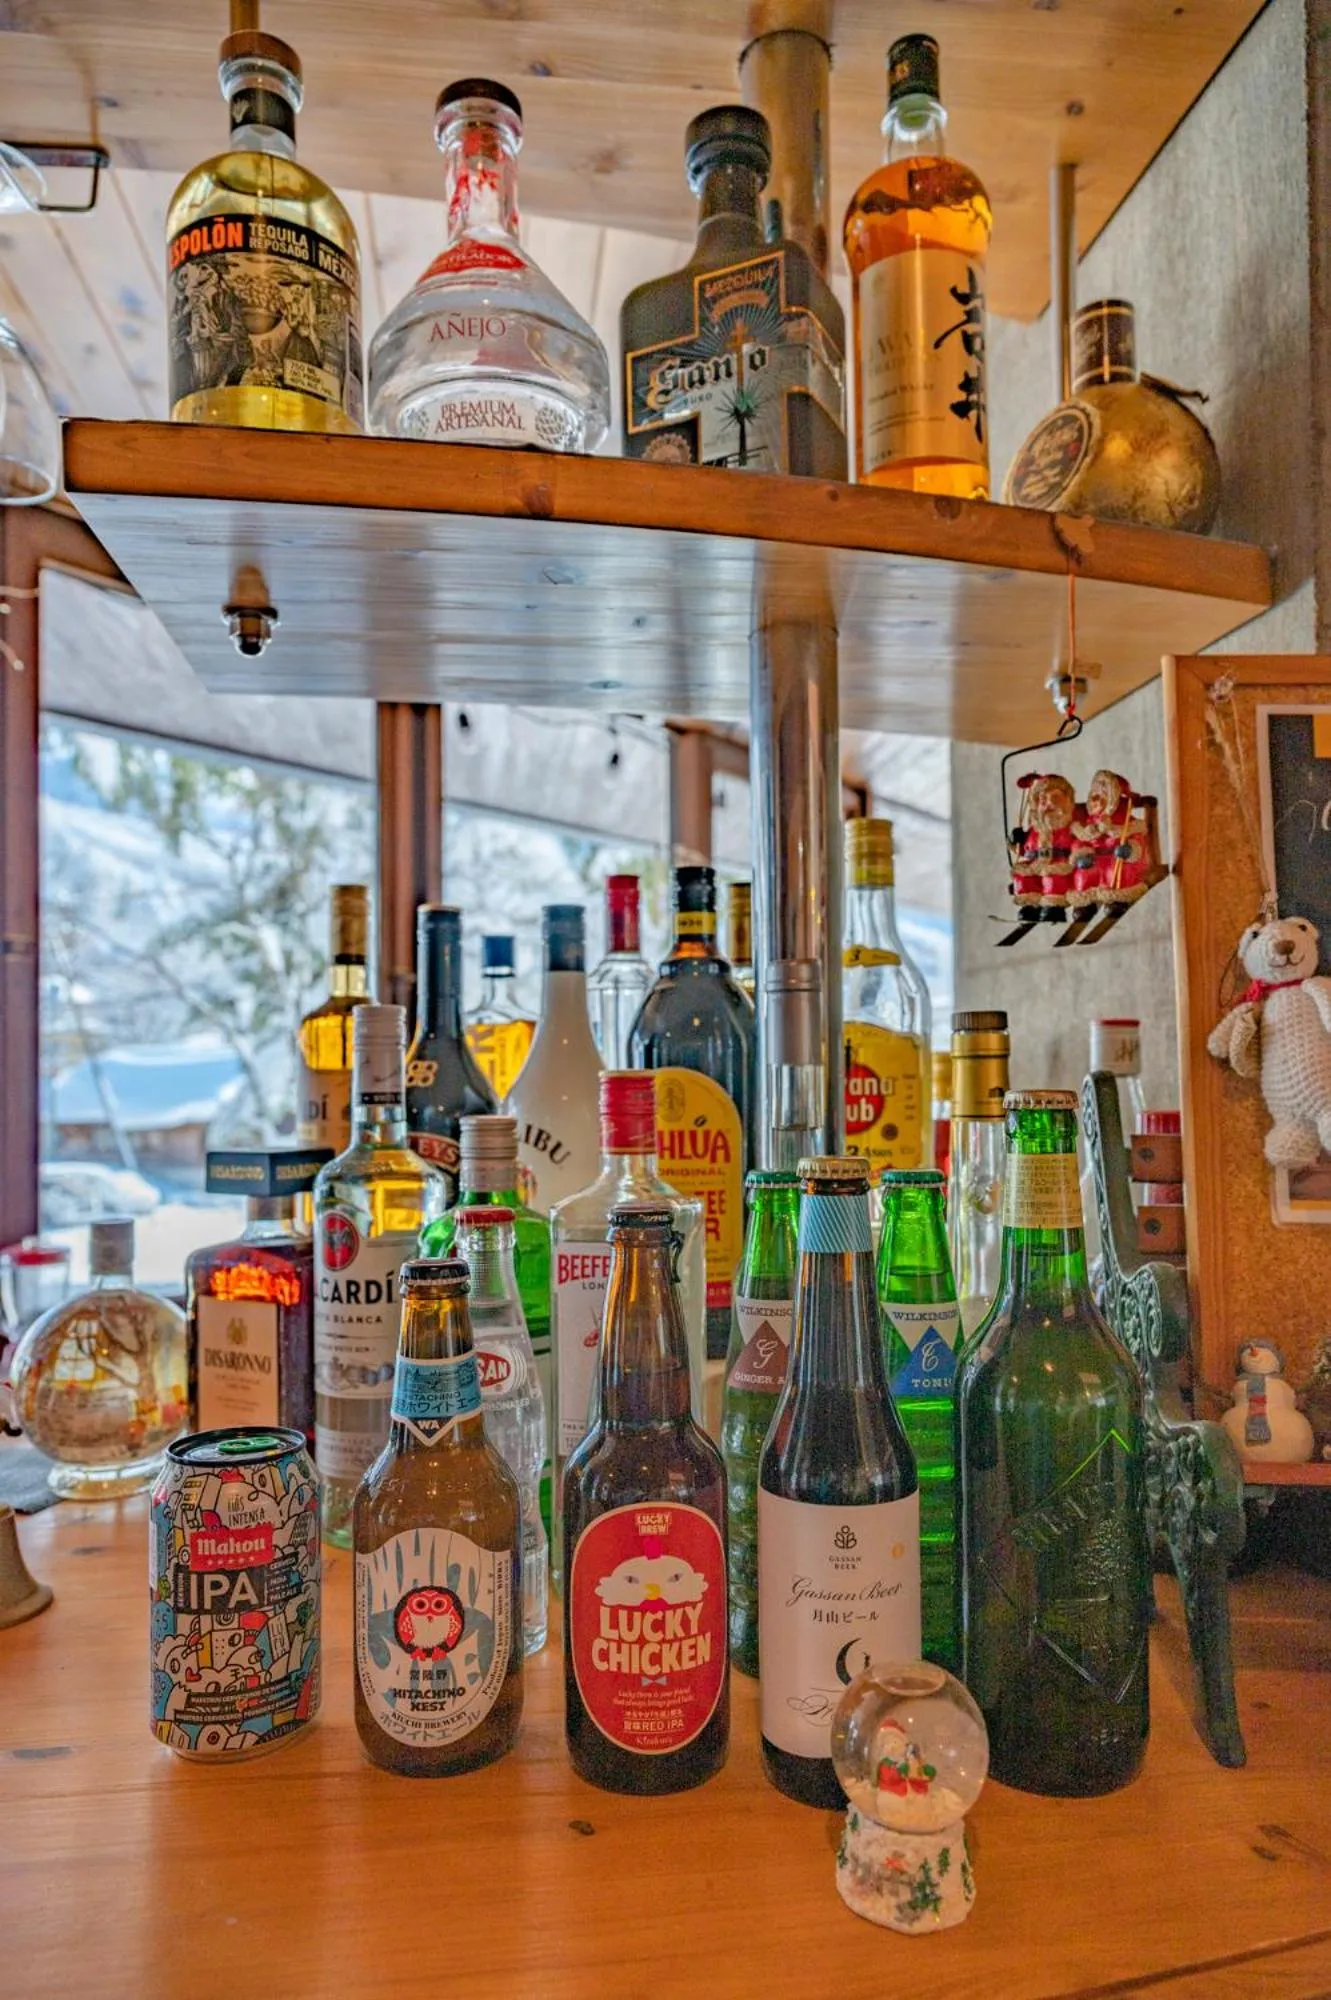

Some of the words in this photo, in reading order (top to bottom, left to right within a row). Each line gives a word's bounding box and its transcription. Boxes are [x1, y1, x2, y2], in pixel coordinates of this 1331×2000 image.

[248, 222, 309, 249] TEQUILA
[249, 236, 310, 260] REPOSADO
[429, 313, 506, 341] AÑEJO
[435, 410, 525, 434] ARTESANAL
[441, 400, 517, 418] PREMIUM
[846, 1098, 875, 1122] ub
[524, 1124, 571, 1165] IBU
[558, 1254, 611, 1285] BEEFE
[320, 1270, 395, 1305] CARDÍ
[582, 1282, 604, 1290] LON
[204, 1348, 272, 1375] DISARONNO
[190, 1571, 259, 1609] IPA
[600, 1602, 703, 1642] LUCKY
[592, 1632, 711, 1676] CHICKEN
[392, 1687, 465, 1699] HITACHINO
